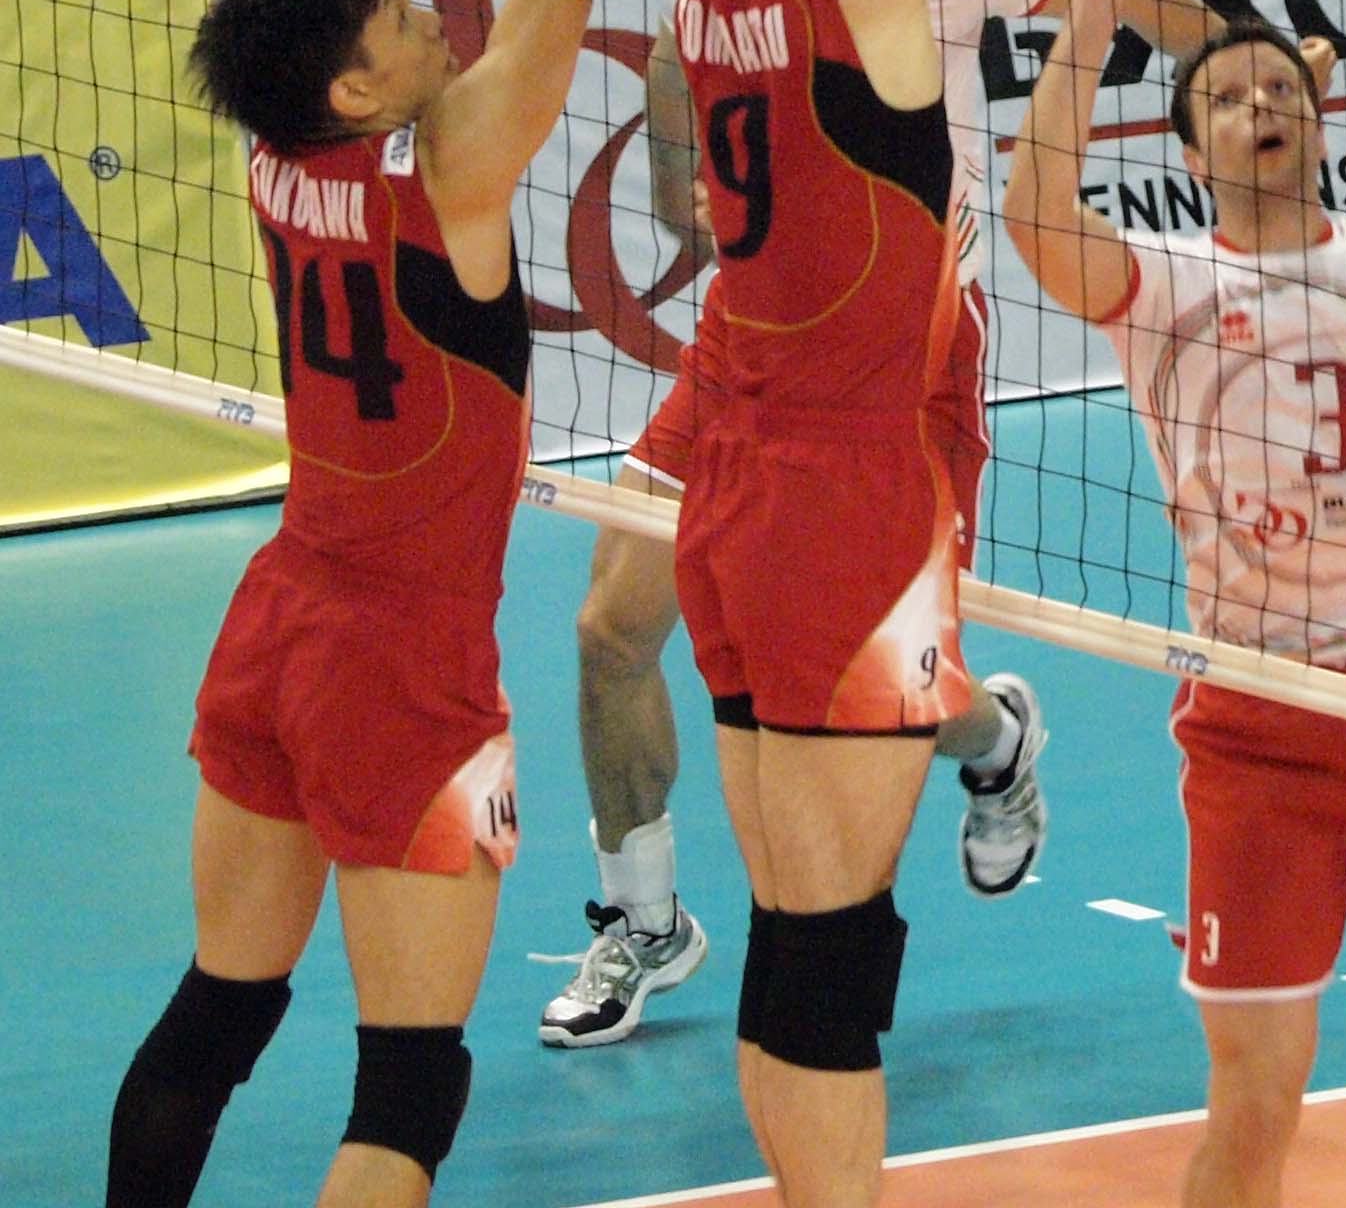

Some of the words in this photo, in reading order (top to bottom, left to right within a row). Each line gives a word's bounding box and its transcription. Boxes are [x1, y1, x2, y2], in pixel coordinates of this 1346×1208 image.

[706, 94, 773, 259] 9
[487, 790, 517, 837] 14
[1200, 910, 1220, 967] 3
